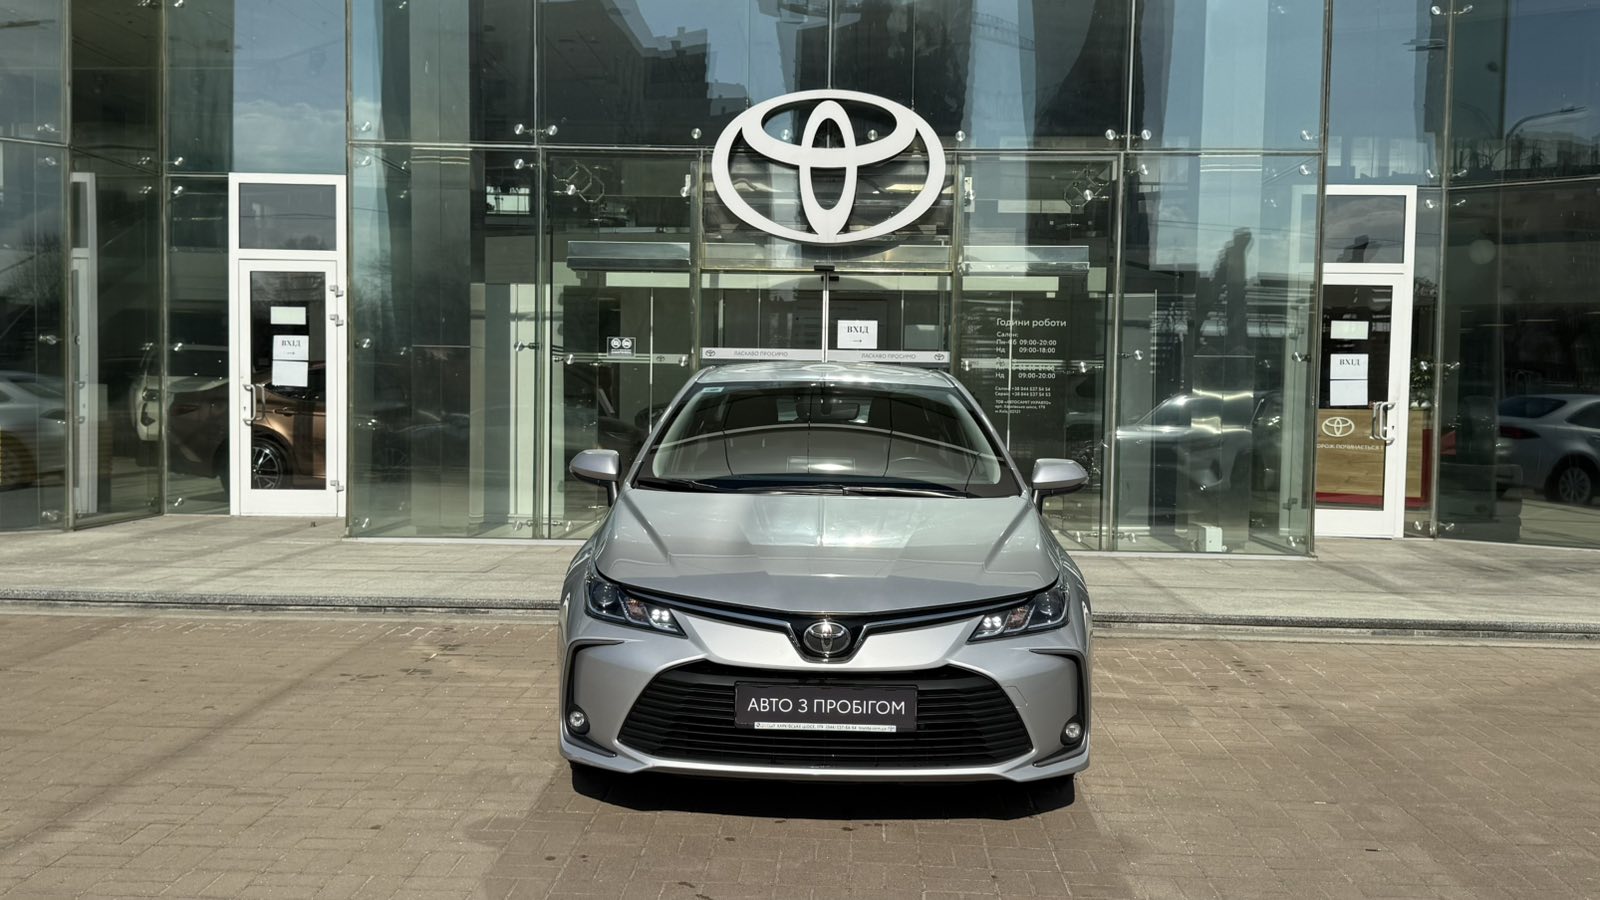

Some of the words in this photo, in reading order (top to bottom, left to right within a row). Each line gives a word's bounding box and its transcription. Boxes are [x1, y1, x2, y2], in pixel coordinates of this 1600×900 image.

[996, 318, 1030, 327] Години
[1032, 318, 1067, 328] роботи
[847, 325, 869, 334] ВХІД
[747, 698, 793, 712] АВТО
[798, 699, 808, 713] З
[813, 699, 905, 715] ПРОБІГОМ
